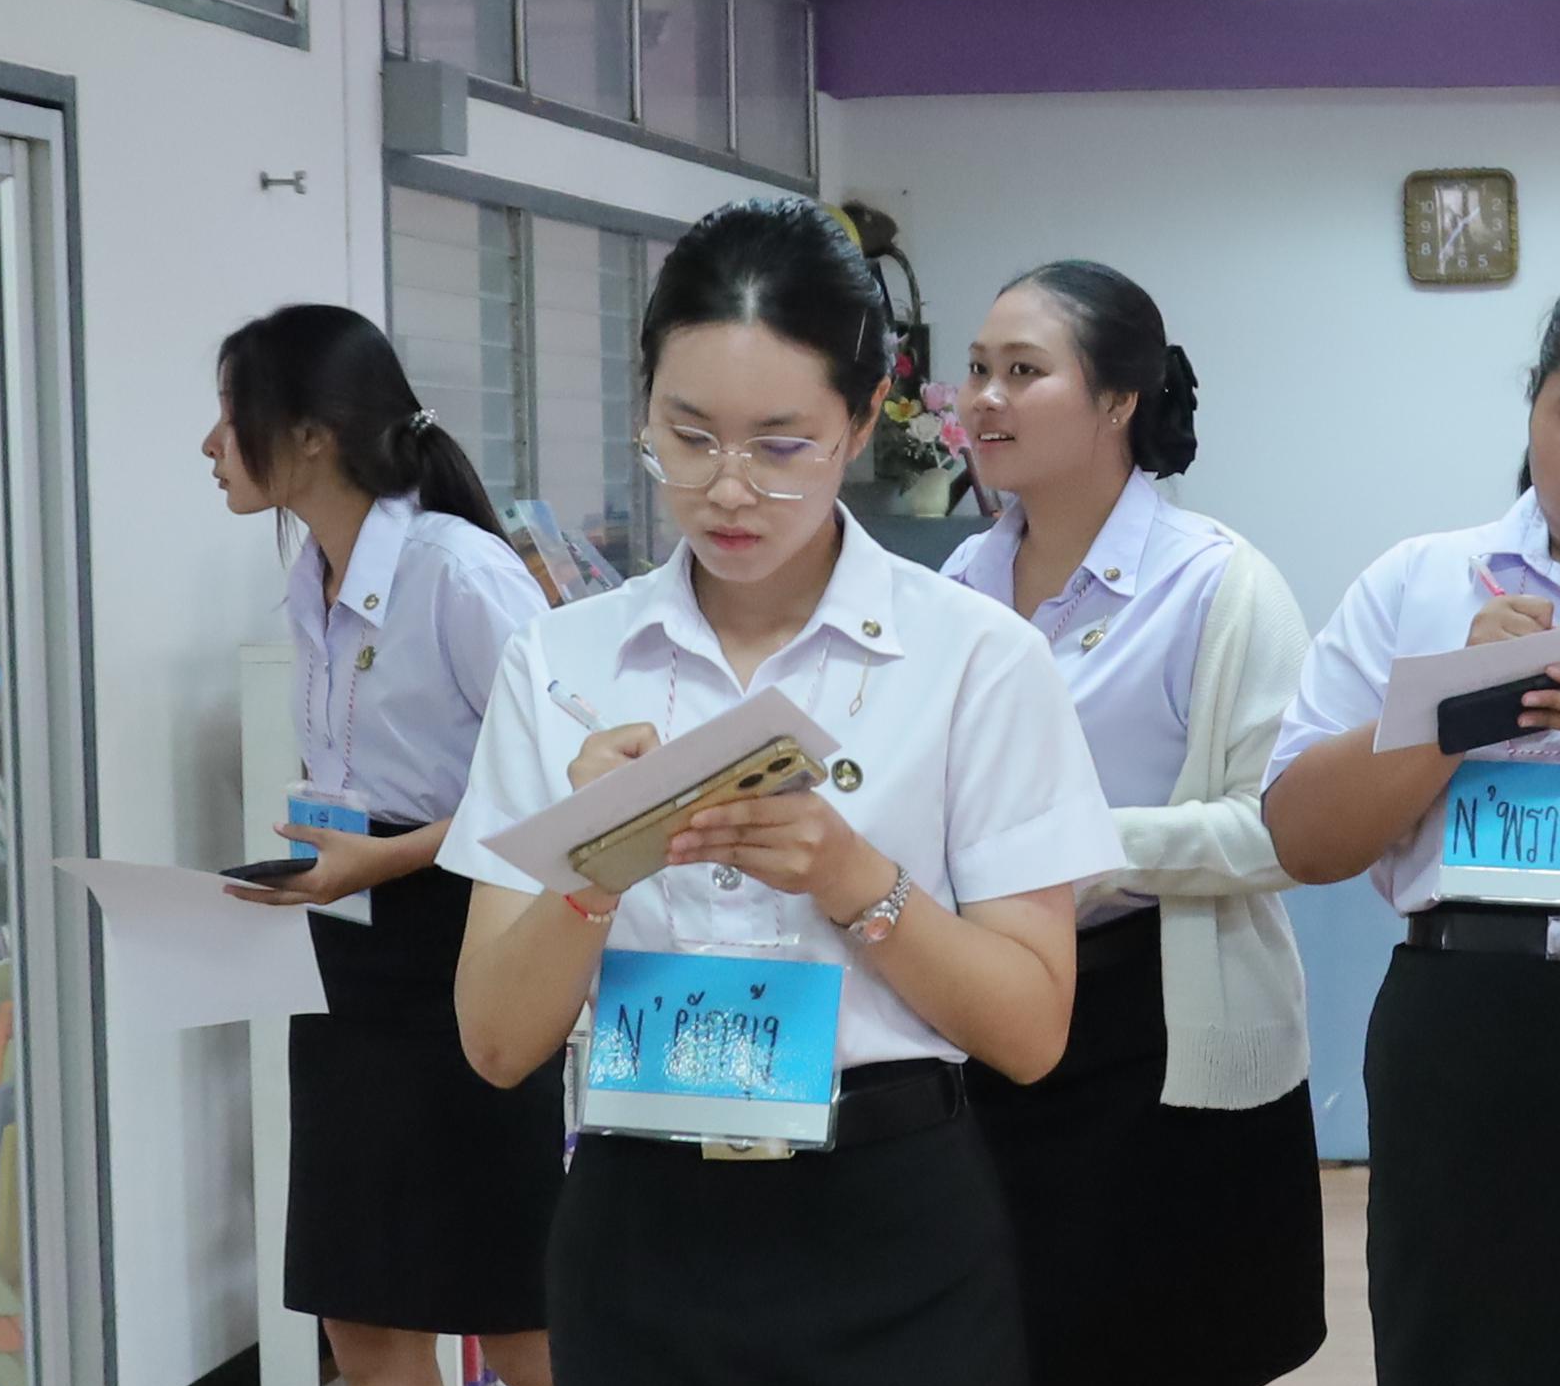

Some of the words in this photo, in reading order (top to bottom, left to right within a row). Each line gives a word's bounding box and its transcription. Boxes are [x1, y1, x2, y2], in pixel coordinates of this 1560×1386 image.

[1417, 200, 1434, 213] 10
[1491, 197, 1502, 211] 2
[1420, 219, 1431, 233] 9
[1491, 217, 1503, 231] 3
[1420, 242, 1432, 255] 8
[1492, 239, 1503, 253] 4
[1457, 254, 1468, 268] 6
[1477, 253, 1488, 268] 5
